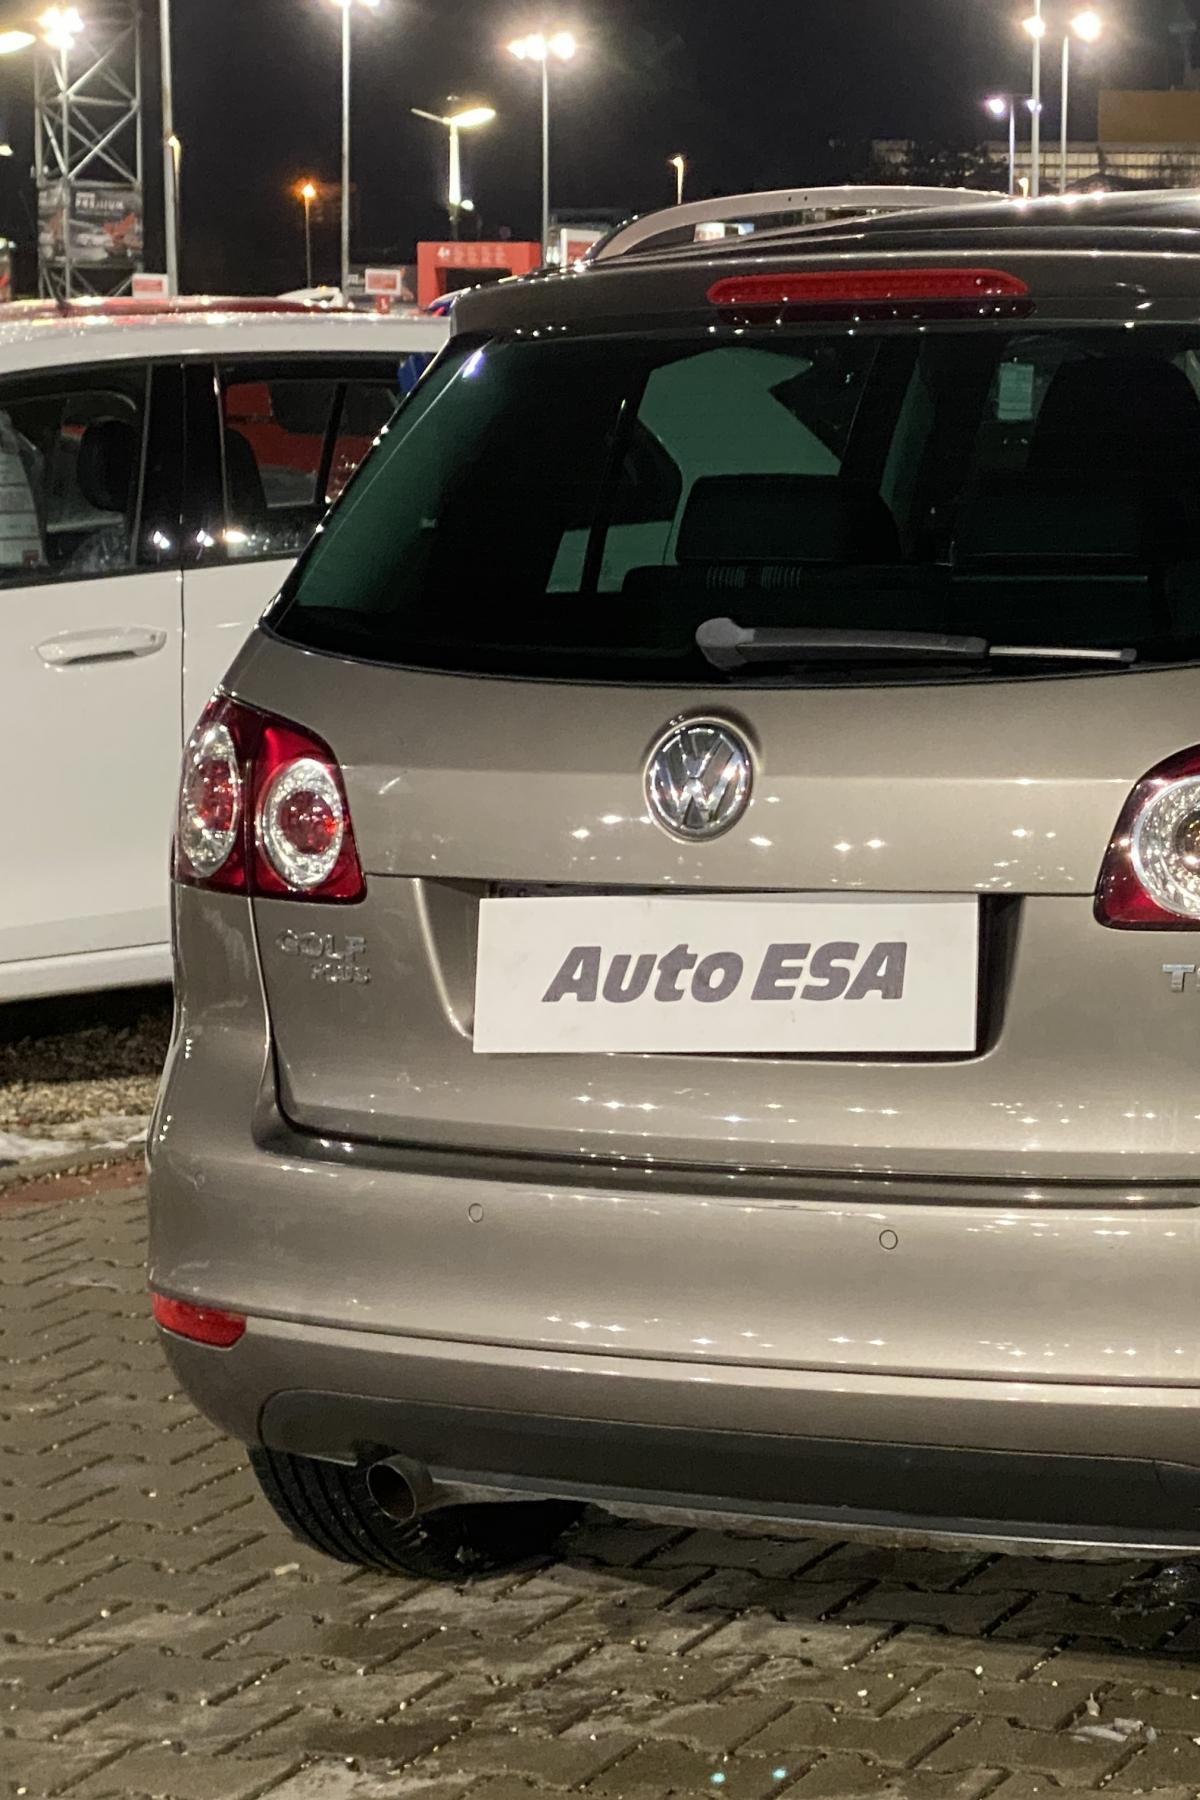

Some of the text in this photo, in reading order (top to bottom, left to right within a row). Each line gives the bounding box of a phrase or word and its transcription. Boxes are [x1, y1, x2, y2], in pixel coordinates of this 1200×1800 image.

[278, 928, 367, 961] GOLF
[541, 941, 908, 1003] Auto ESA
